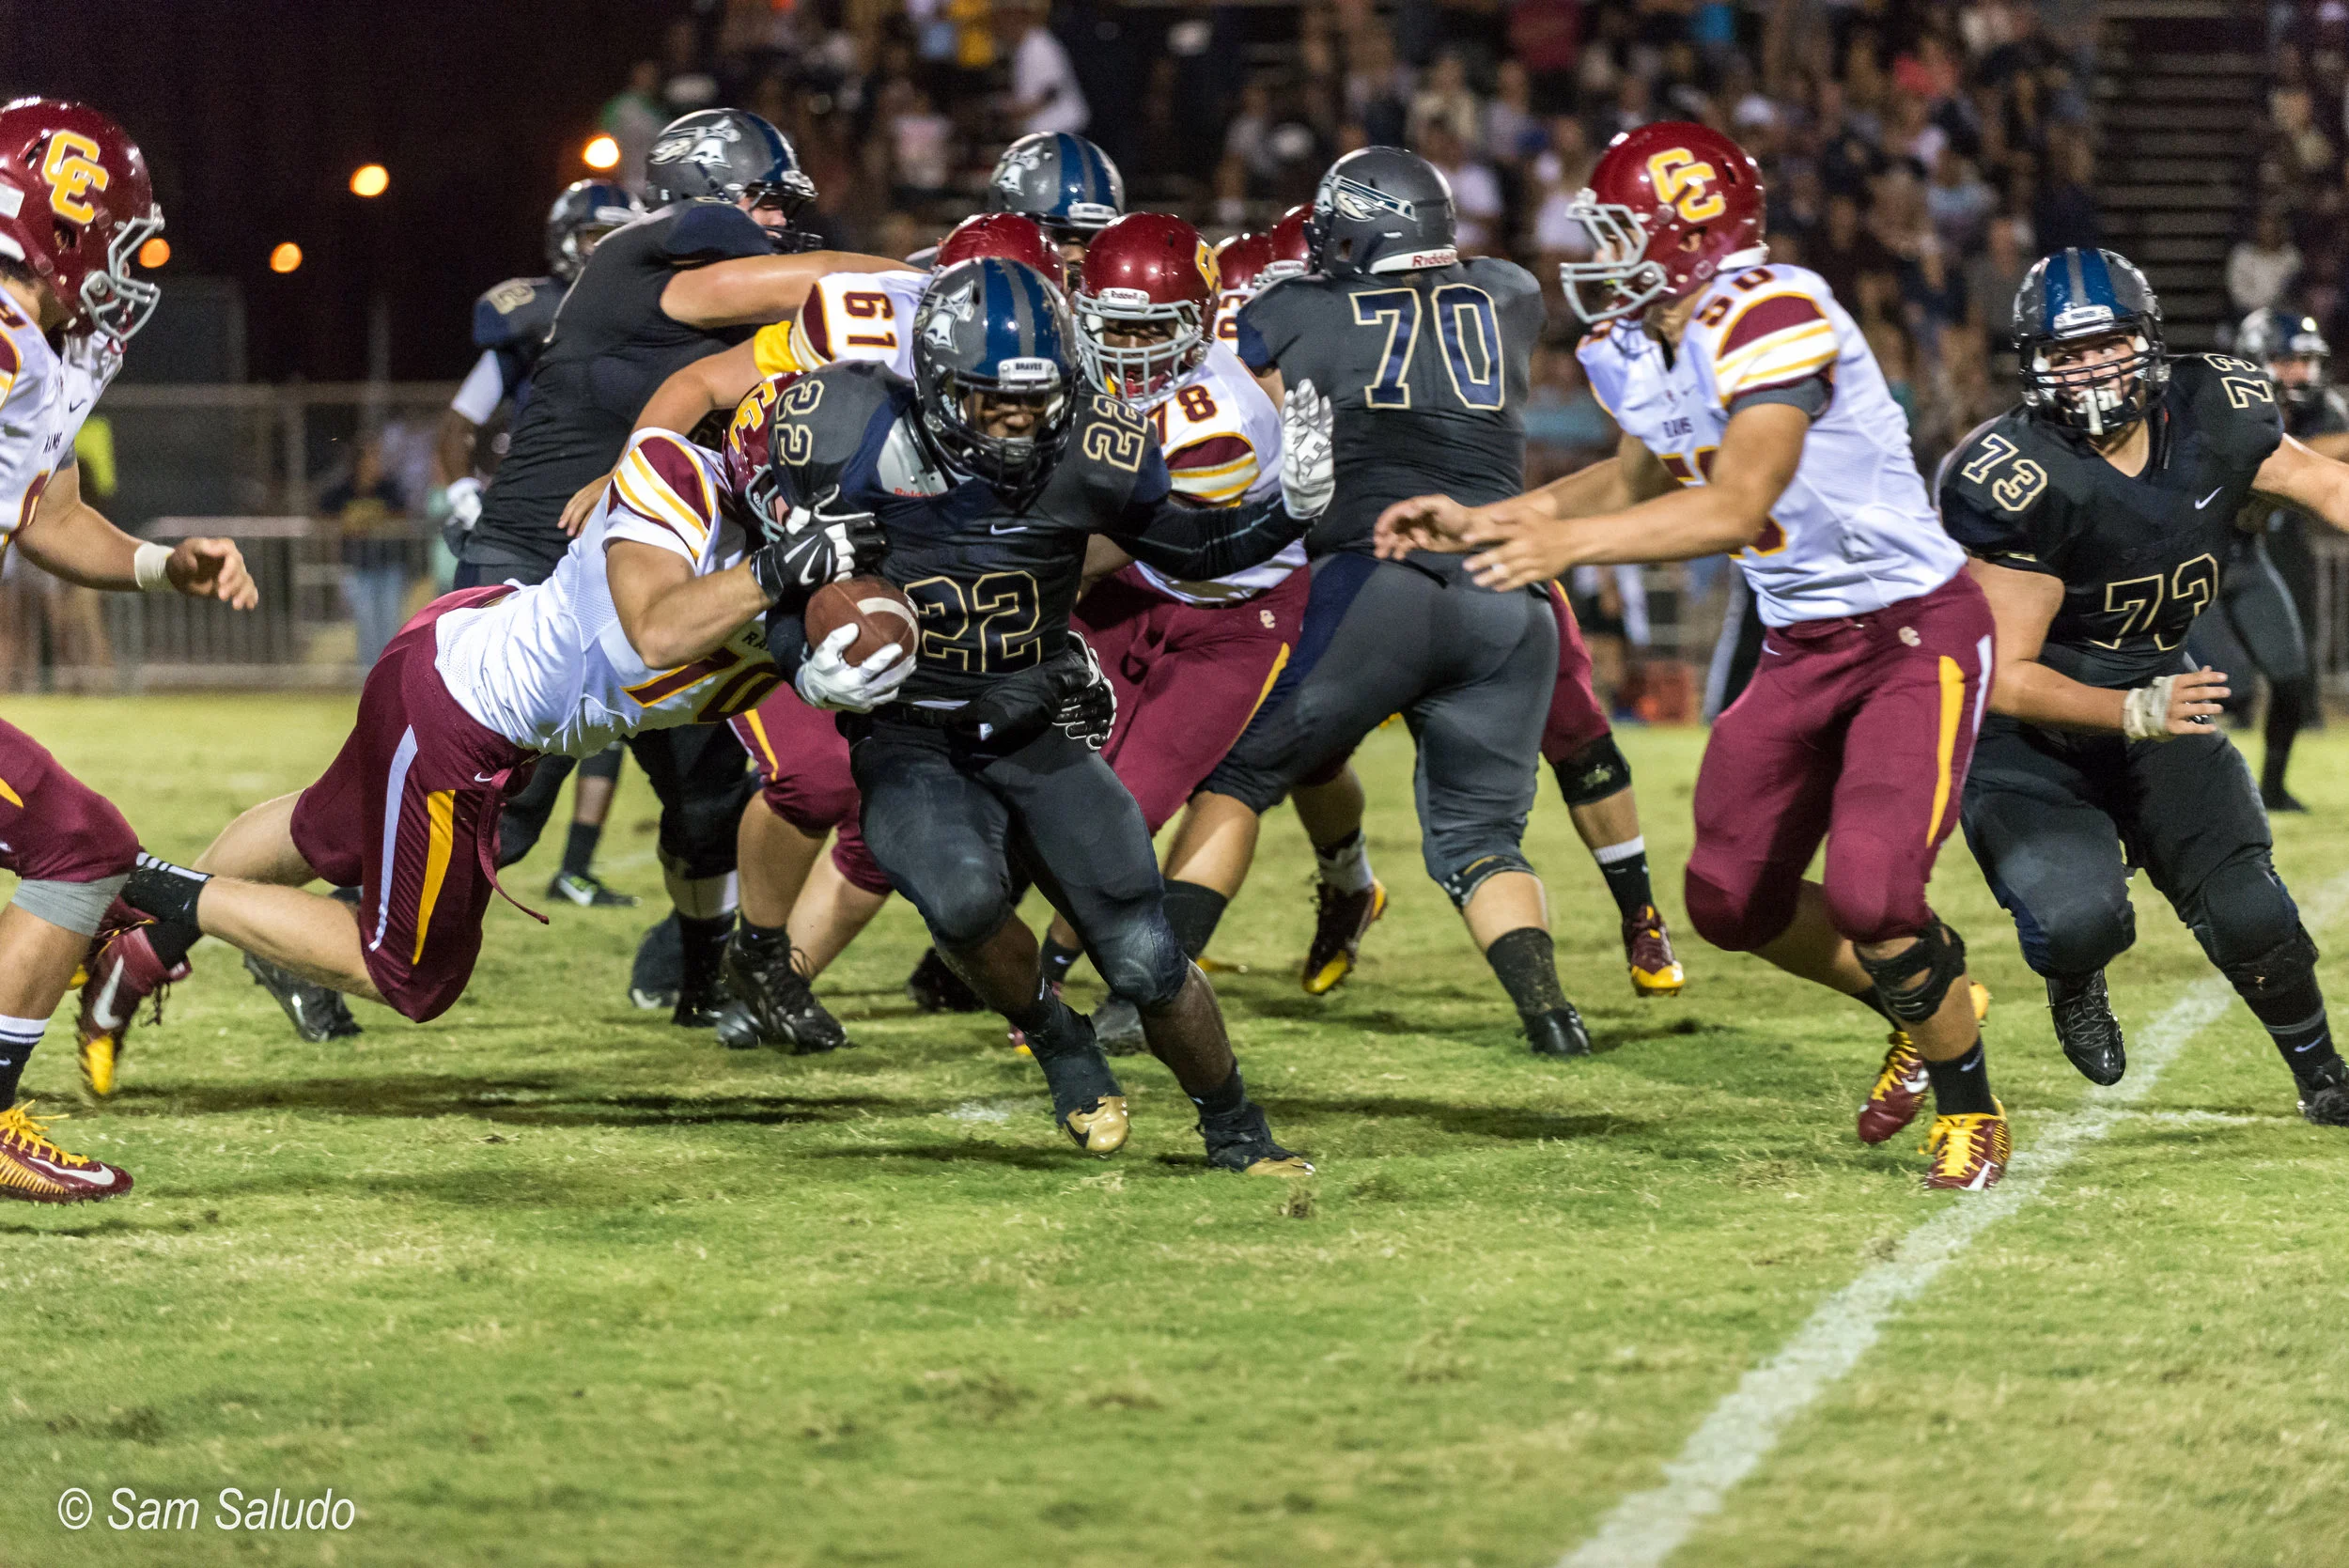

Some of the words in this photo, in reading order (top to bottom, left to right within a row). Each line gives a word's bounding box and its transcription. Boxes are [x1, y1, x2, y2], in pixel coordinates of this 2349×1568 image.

[842, 290, 898, 350] 61
[1347, 283, 1505, 411] 70
[1145, 384, 1219, 449] 78
[2202, 352, 2275, 410] 73
[774, 380, 825, 466] 22
[1082, 394, 1149, 473] 22
[1961, 432, 2048, 512] 73
[904, 569, 1041, 674] 22
[2086, 552, 2219, 651] 73
